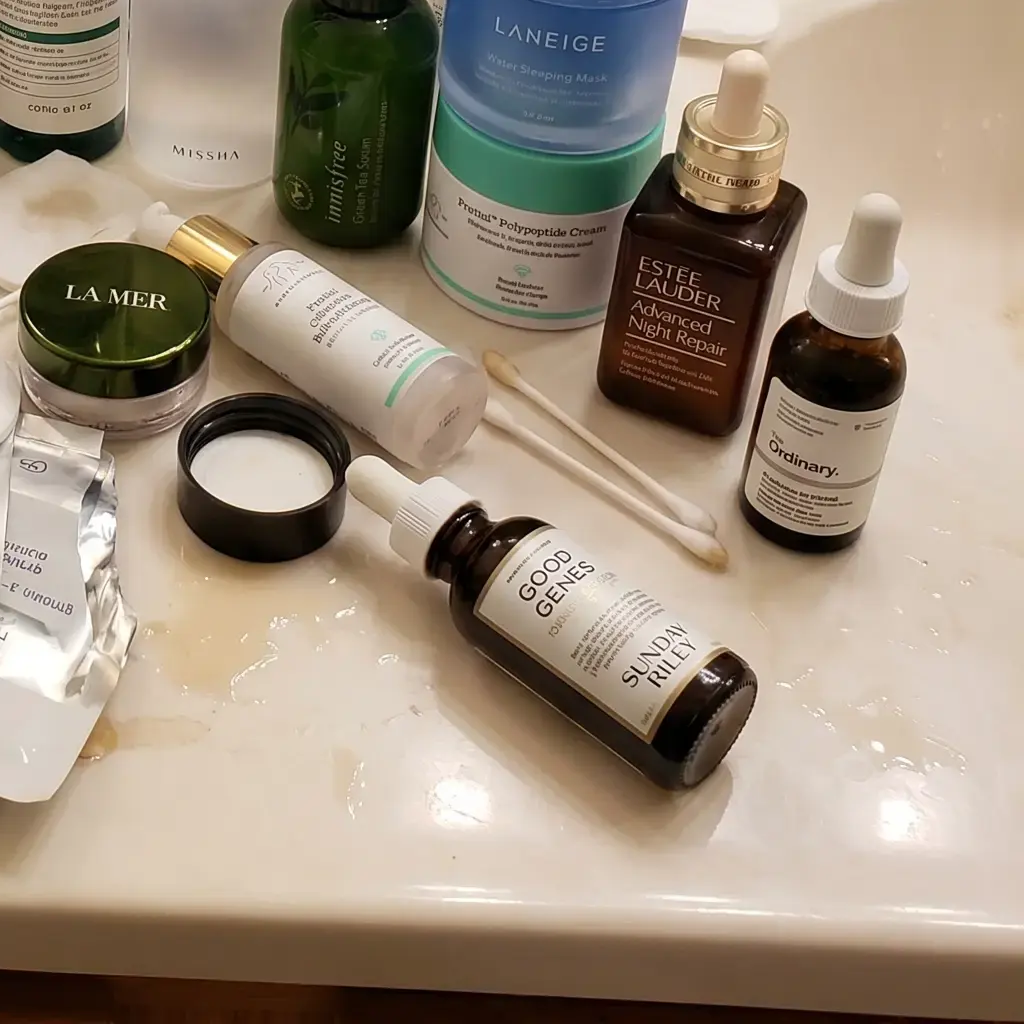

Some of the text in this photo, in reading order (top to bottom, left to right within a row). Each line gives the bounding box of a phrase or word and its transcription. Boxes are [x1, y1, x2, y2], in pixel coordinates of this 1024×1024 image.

[494, 16, 607, 53] LANEIGE
[173, 144, 239, 161] MISSHA
[325, 141, 348, 223] innisfree
[569, 223, 608, 237] Cream
[65, 284, 168, 311] LA MER
[635, 272, 721, 311] LAUDER
[628, 316, 727, 358] Night Repair
[629, 299, 713, 335] Advanced
[518, 549, 573, 602] GOOD
[535, 560, 596, 618] GENES
[621, 622, 689, 689] SUNDAY
[646, 637, 697, 689] RILEY
